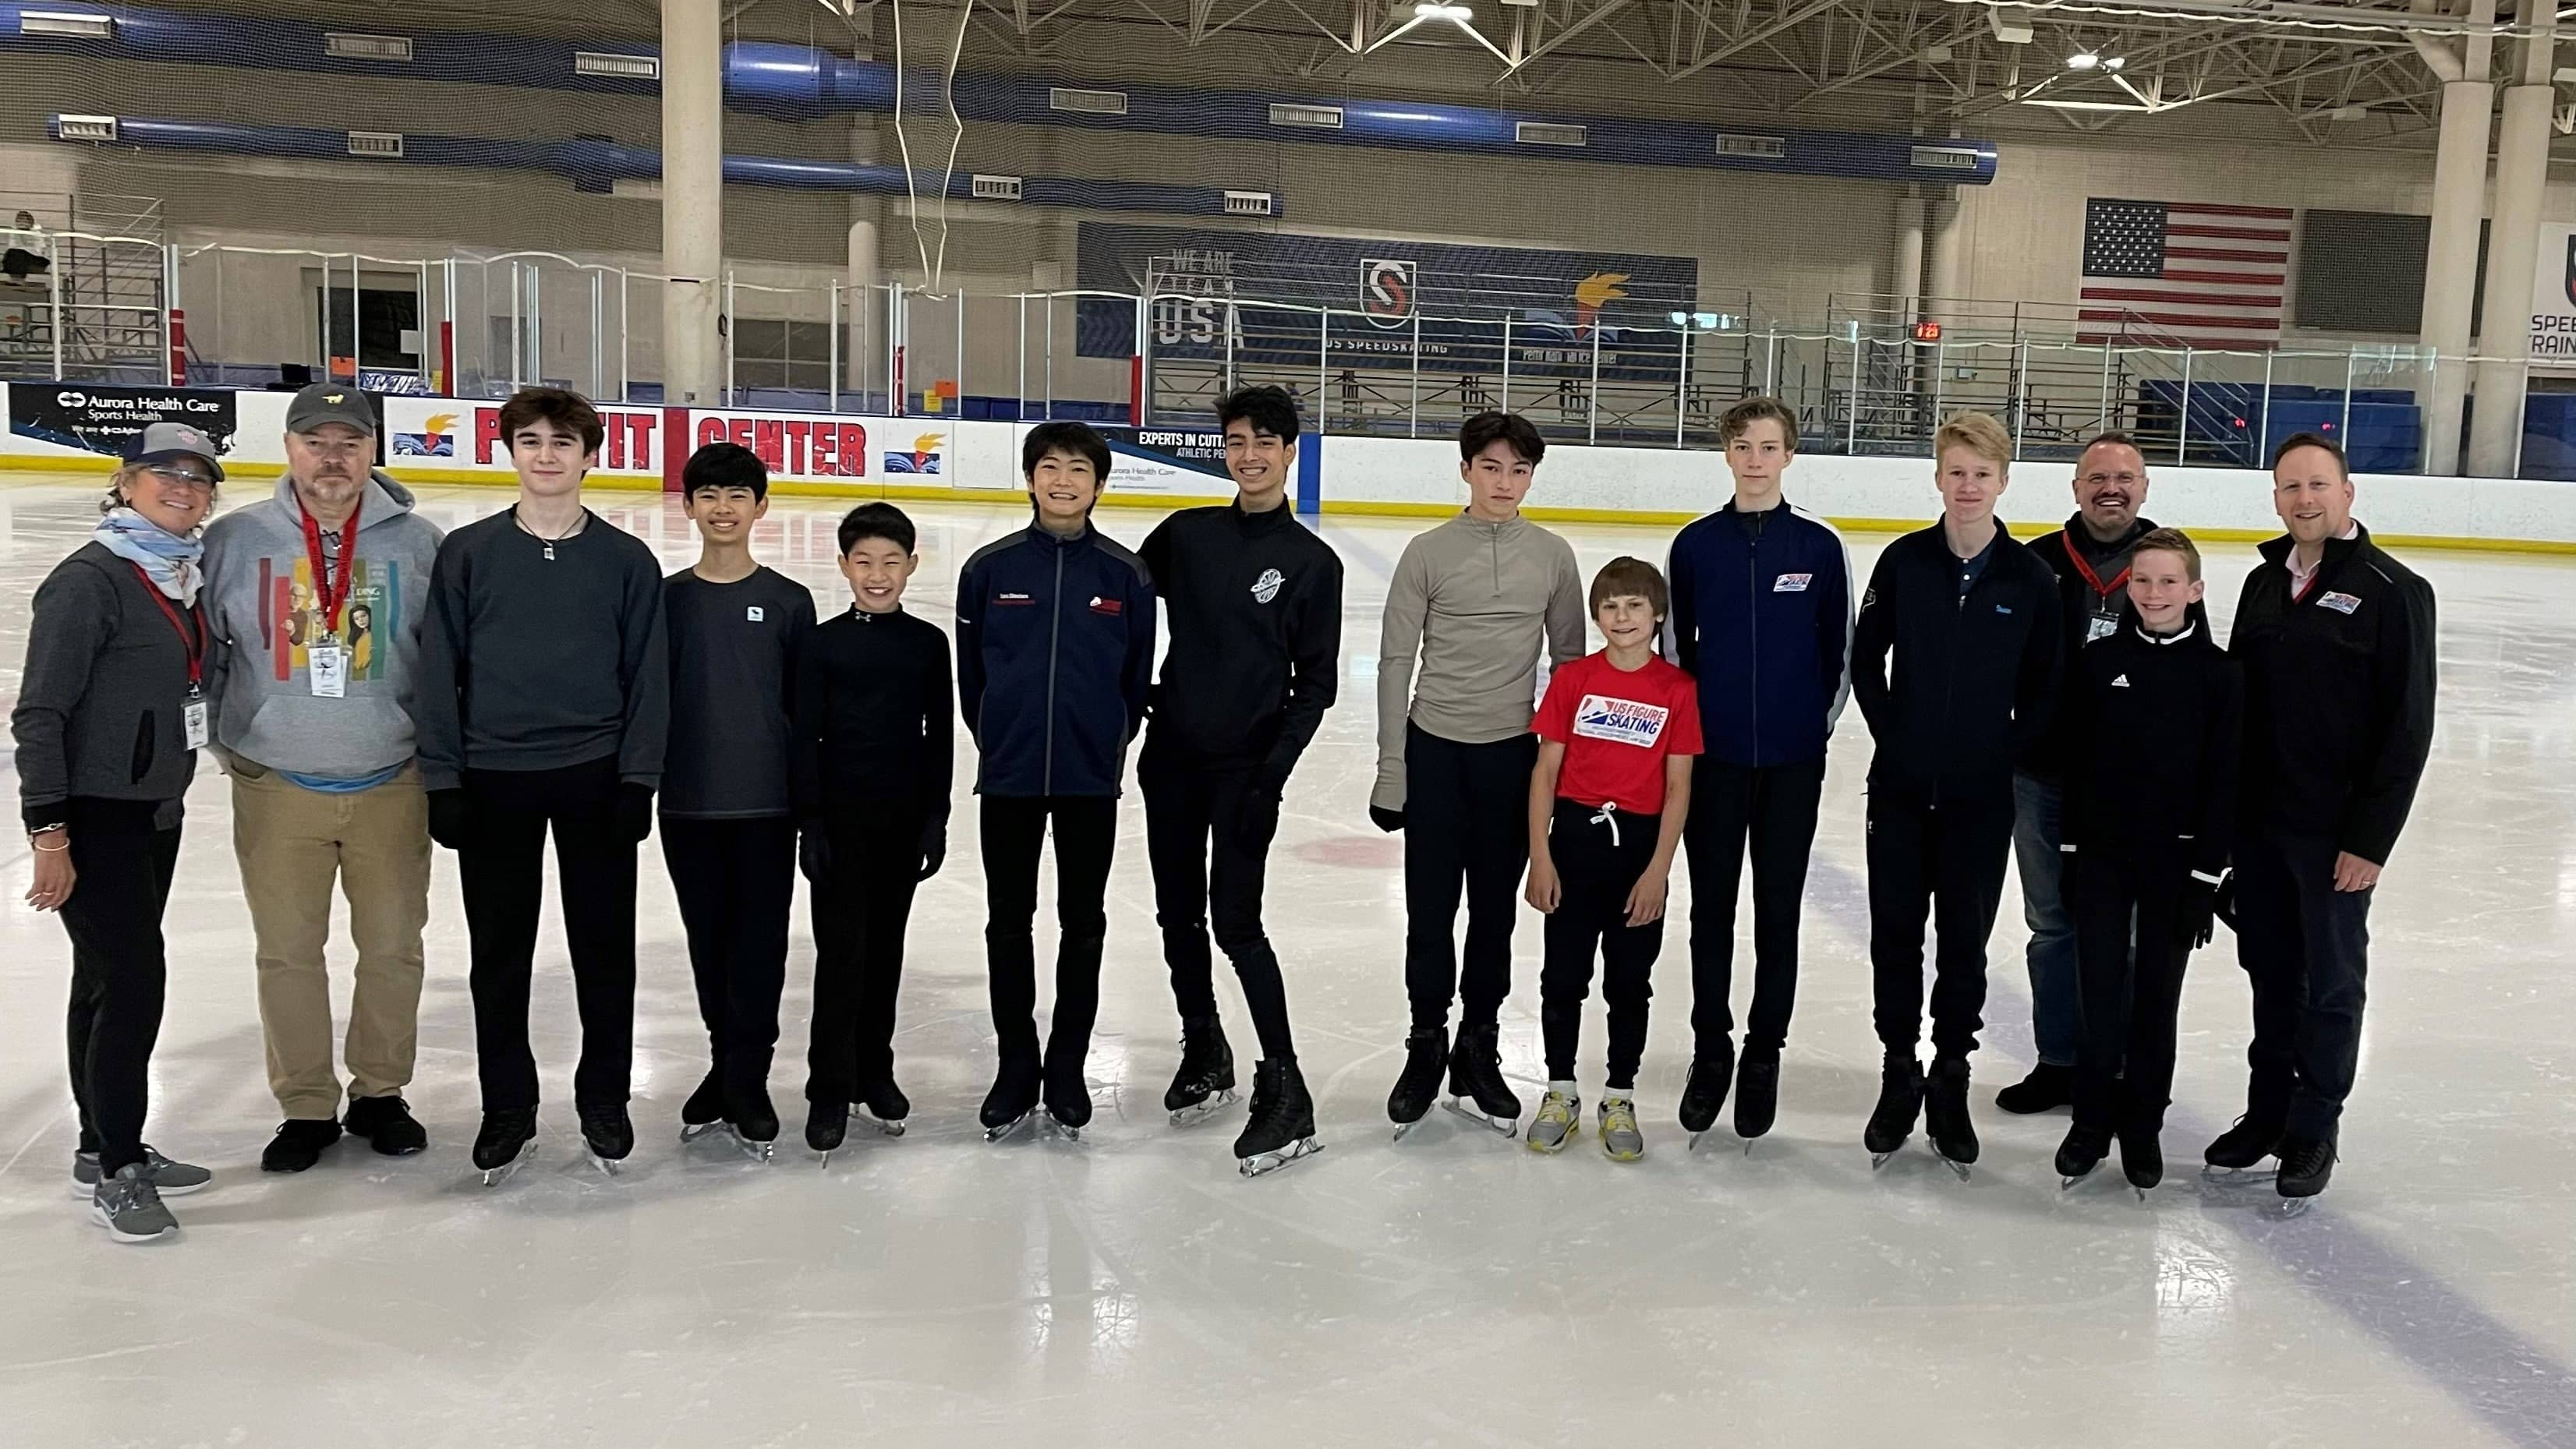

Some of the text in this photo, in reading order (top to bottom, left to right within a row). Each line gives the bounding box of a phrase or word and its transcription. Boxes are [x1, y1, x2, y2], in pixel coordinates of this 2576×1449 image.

[1172, 249, 1234, 274] WE ARE
[1159, 300, 1245, 349] USA
[2528, 334, 2576, 355] RAIN
[88, 395, 219, 412] Aurora Health Care
[87, 408, 162, 422] Sports Health
[1139, 431, 1184, 447] EXPERTS
[1184, 433, 1196, 447] IN
[1176, 447, 1226, 460] ATHLETIC PE
[1607, 712, 1660, 734] SKATING
[1613, 702, 1666, 723] US FIGURE
